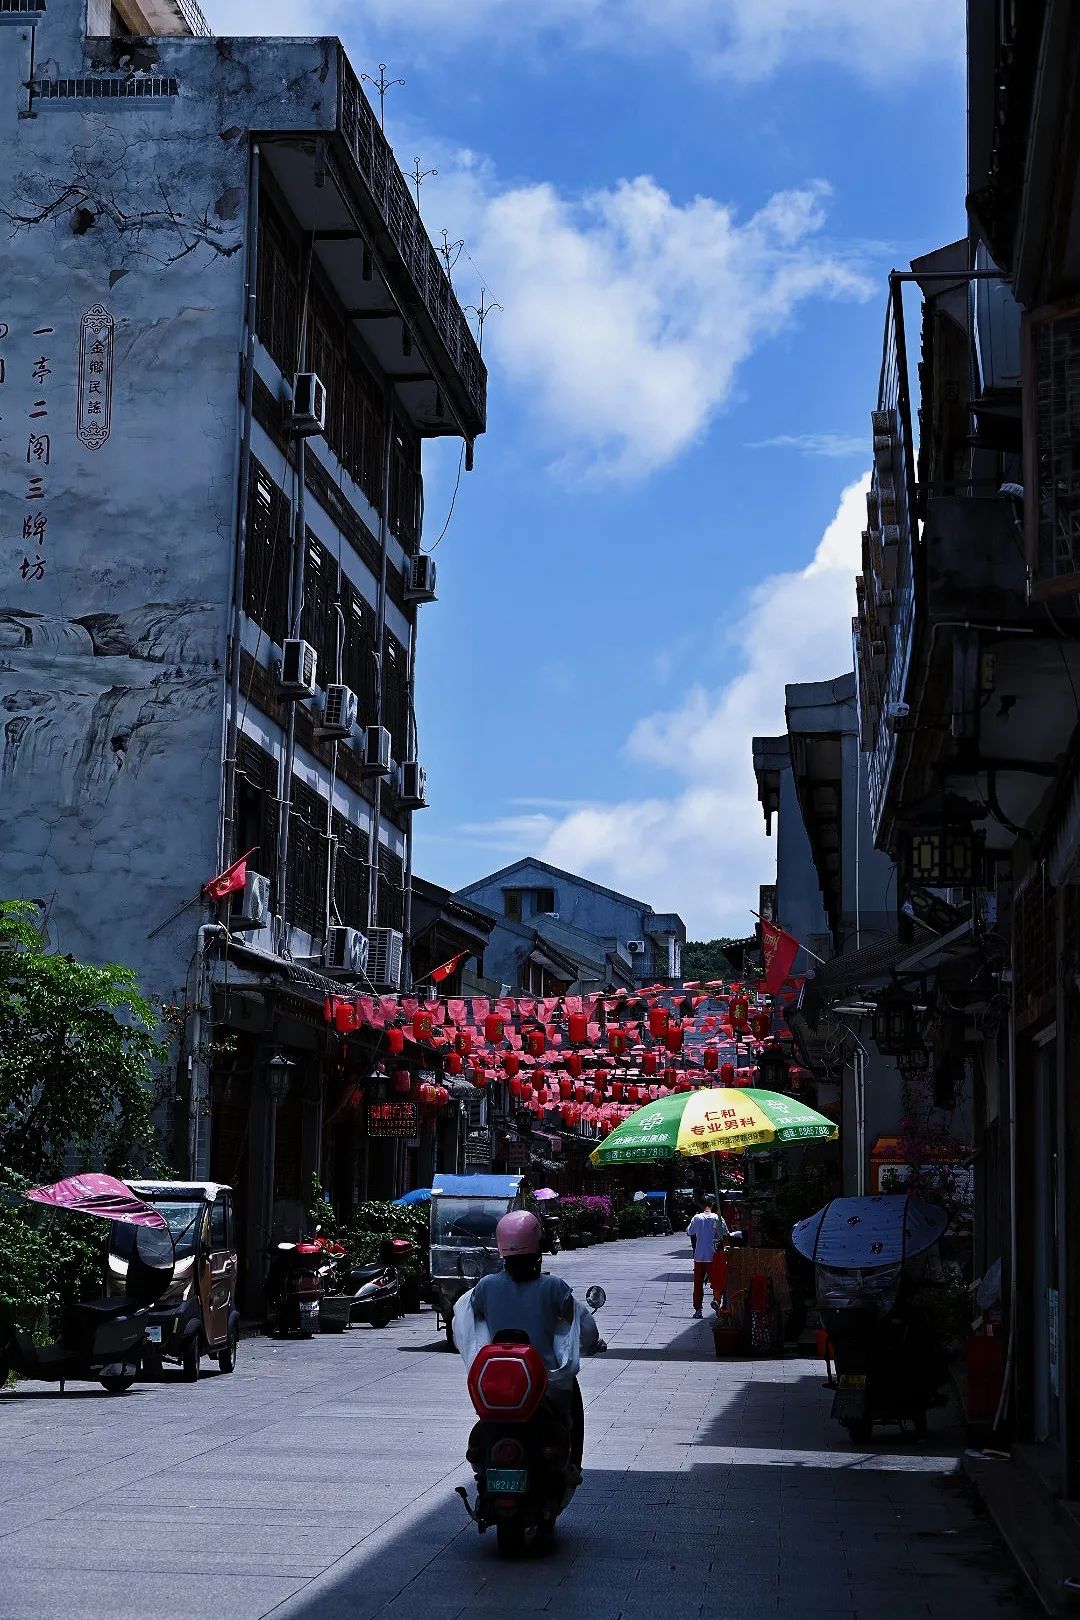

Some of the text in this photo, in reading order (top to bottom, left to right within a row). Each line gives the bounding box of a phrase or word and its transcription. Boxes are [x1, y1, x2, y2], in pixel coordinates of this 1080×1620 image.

[704, 1108, 737, 1121] 仁和
[690, 1117, 757, 1136] 专业男科
